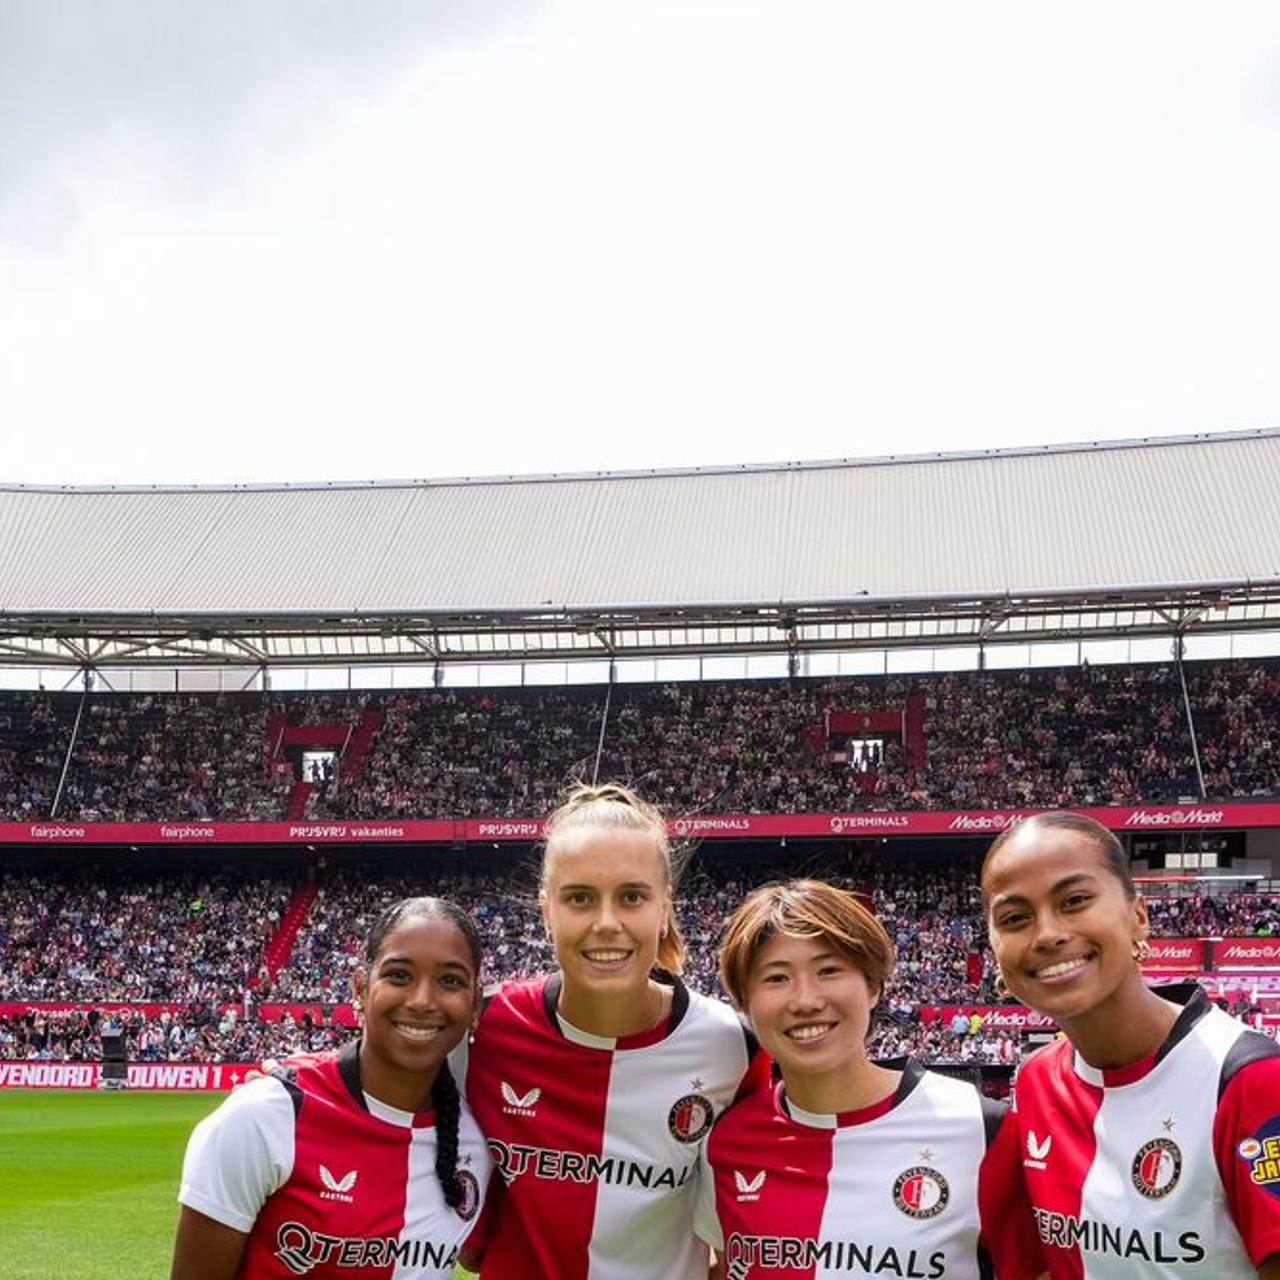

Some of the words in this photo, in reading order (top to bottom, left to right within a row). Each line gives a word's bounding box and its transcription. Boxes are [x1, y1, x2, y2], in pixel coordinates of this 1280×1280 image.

[31, 825, 85, 839] fairphone
[160, 826, 215, 840] fairphone
[351, 825, 404, 837] vakanties
